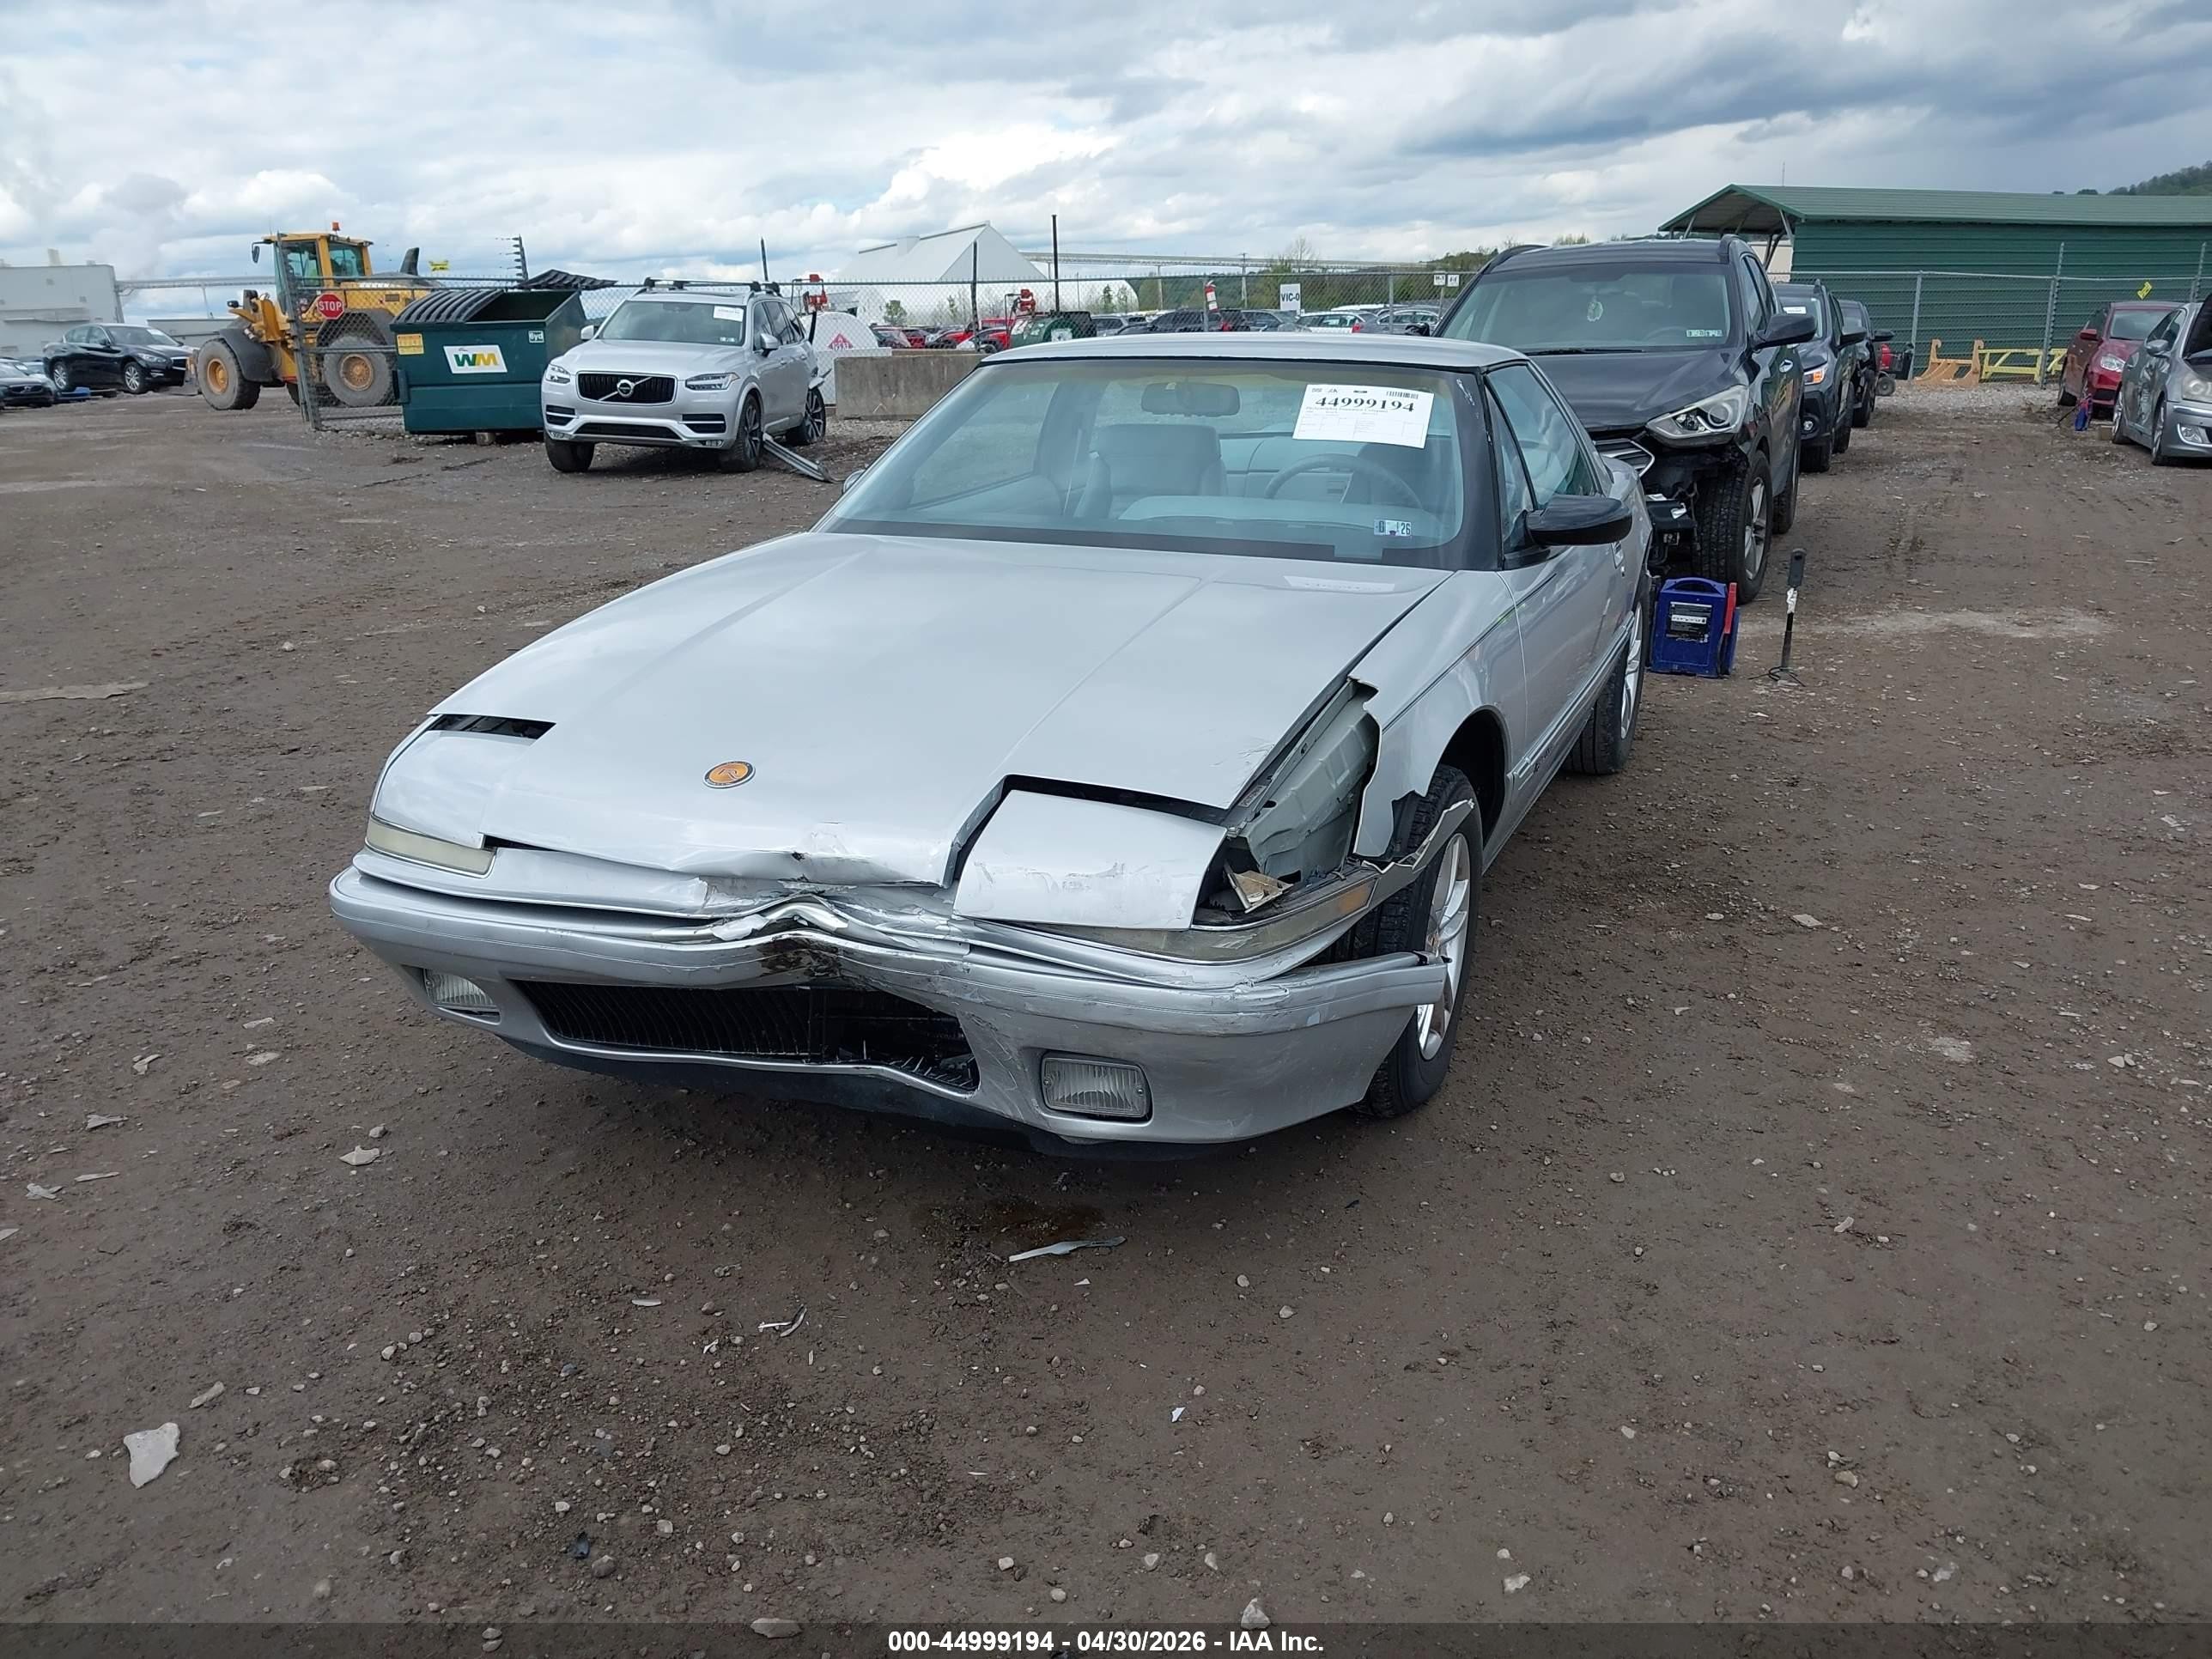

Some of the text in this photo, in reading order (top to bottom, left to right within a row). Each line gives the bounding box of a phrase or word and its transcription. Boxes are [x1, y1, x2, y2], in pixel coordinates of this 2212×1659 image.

[319, 301, 343, 312] STOP
[453, 352, 499, 368] WM
[1315, 397, 1415, 412] 44999194
[1401, 522, 1411, 535] 26
